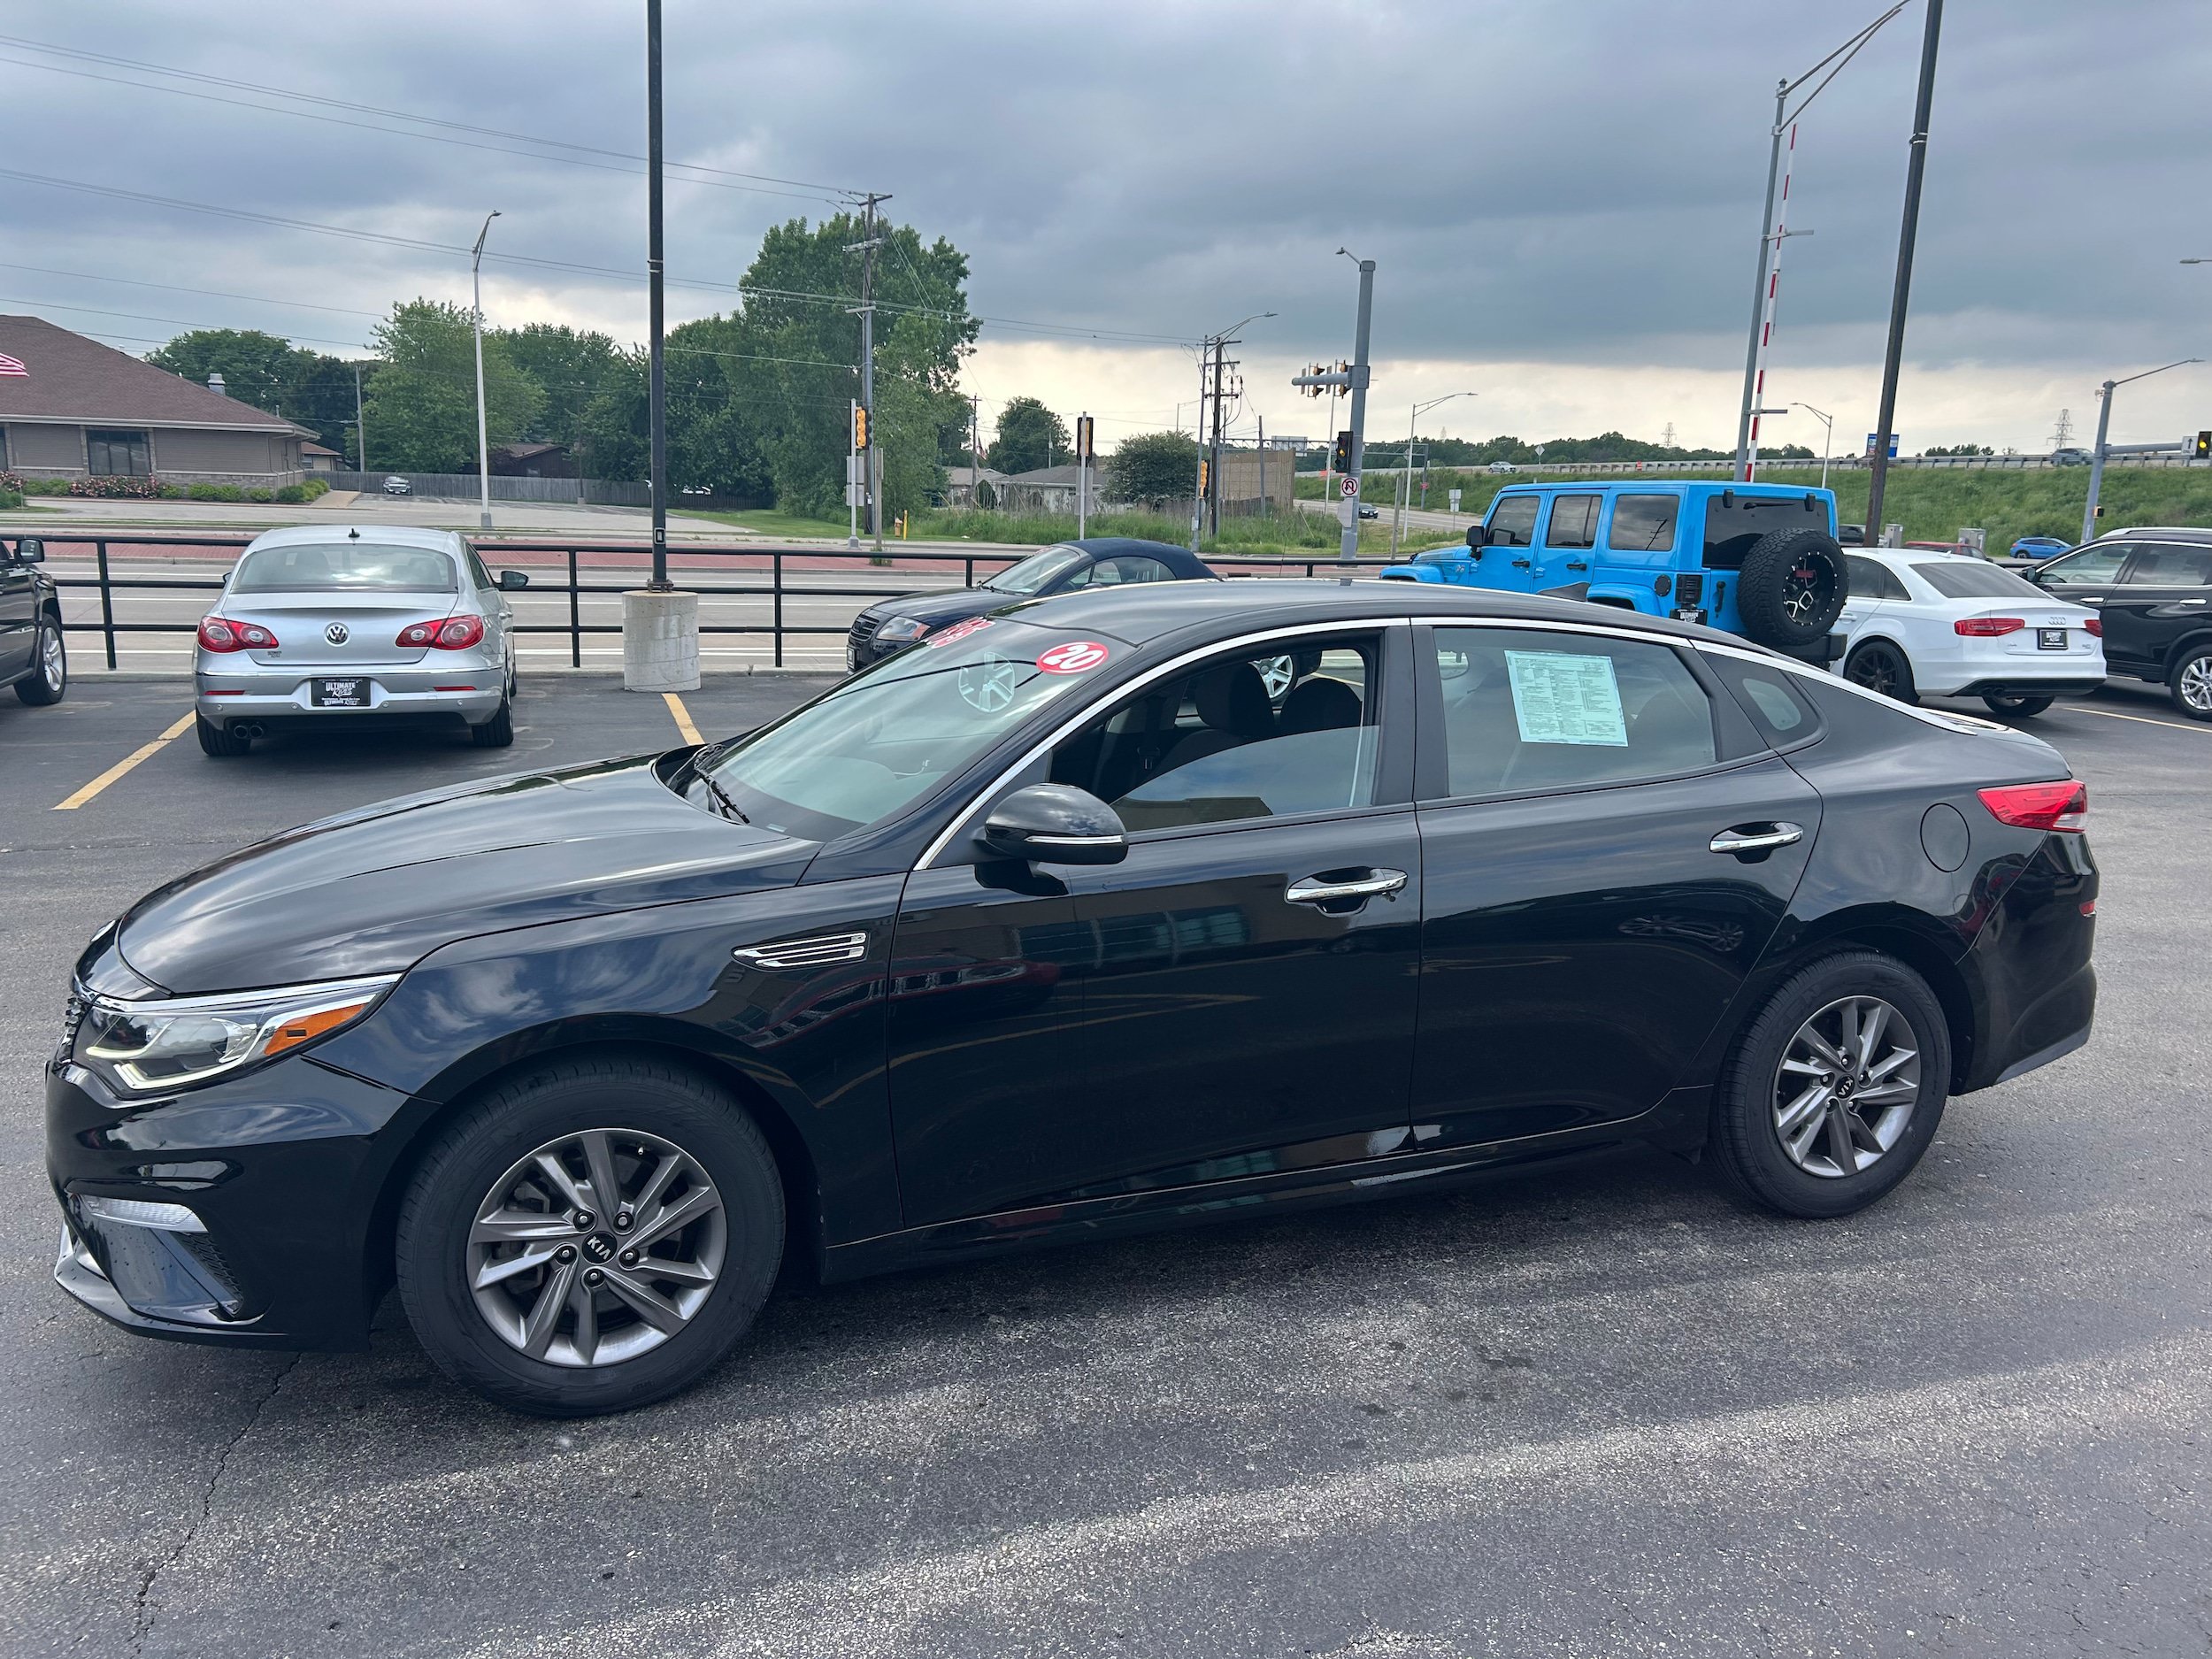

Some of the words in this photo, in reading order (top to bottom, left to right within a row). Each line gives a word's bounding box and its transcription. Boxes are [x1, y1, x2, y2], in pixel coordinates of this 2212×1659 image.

[1042, 644, 1104, 670] 20
[325, 681, 357, 692] ULTIMATE
[587, 1235, 611, 1260] KIA
